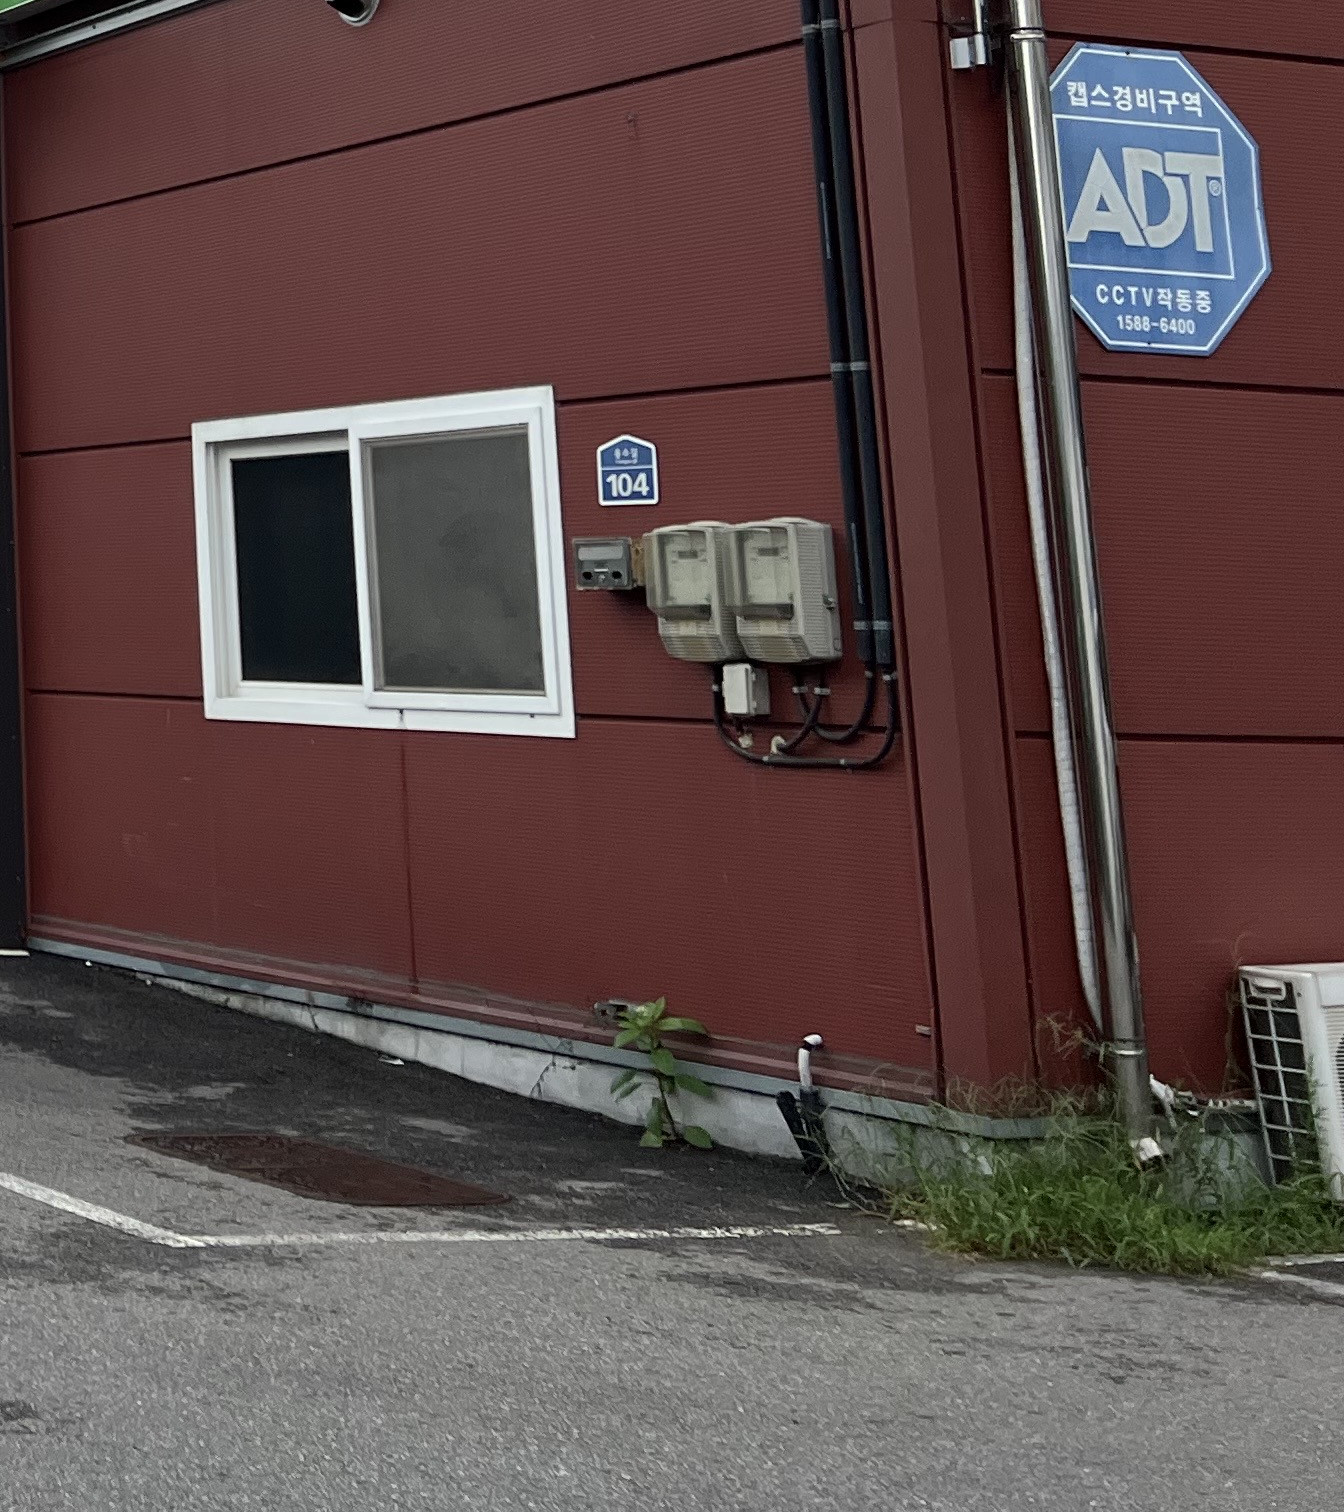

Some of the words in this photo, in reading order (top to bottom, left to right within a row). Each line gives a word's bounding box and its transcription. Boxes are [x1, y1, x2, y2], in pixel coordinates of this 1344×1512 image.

[1066, 80, 1204, 118] 캡스경비구역
[1065, 146, 1224, 253] ADT
[1116, 314, 1196, 335] 1588-6400
[605, 471, 650, 497] 104
